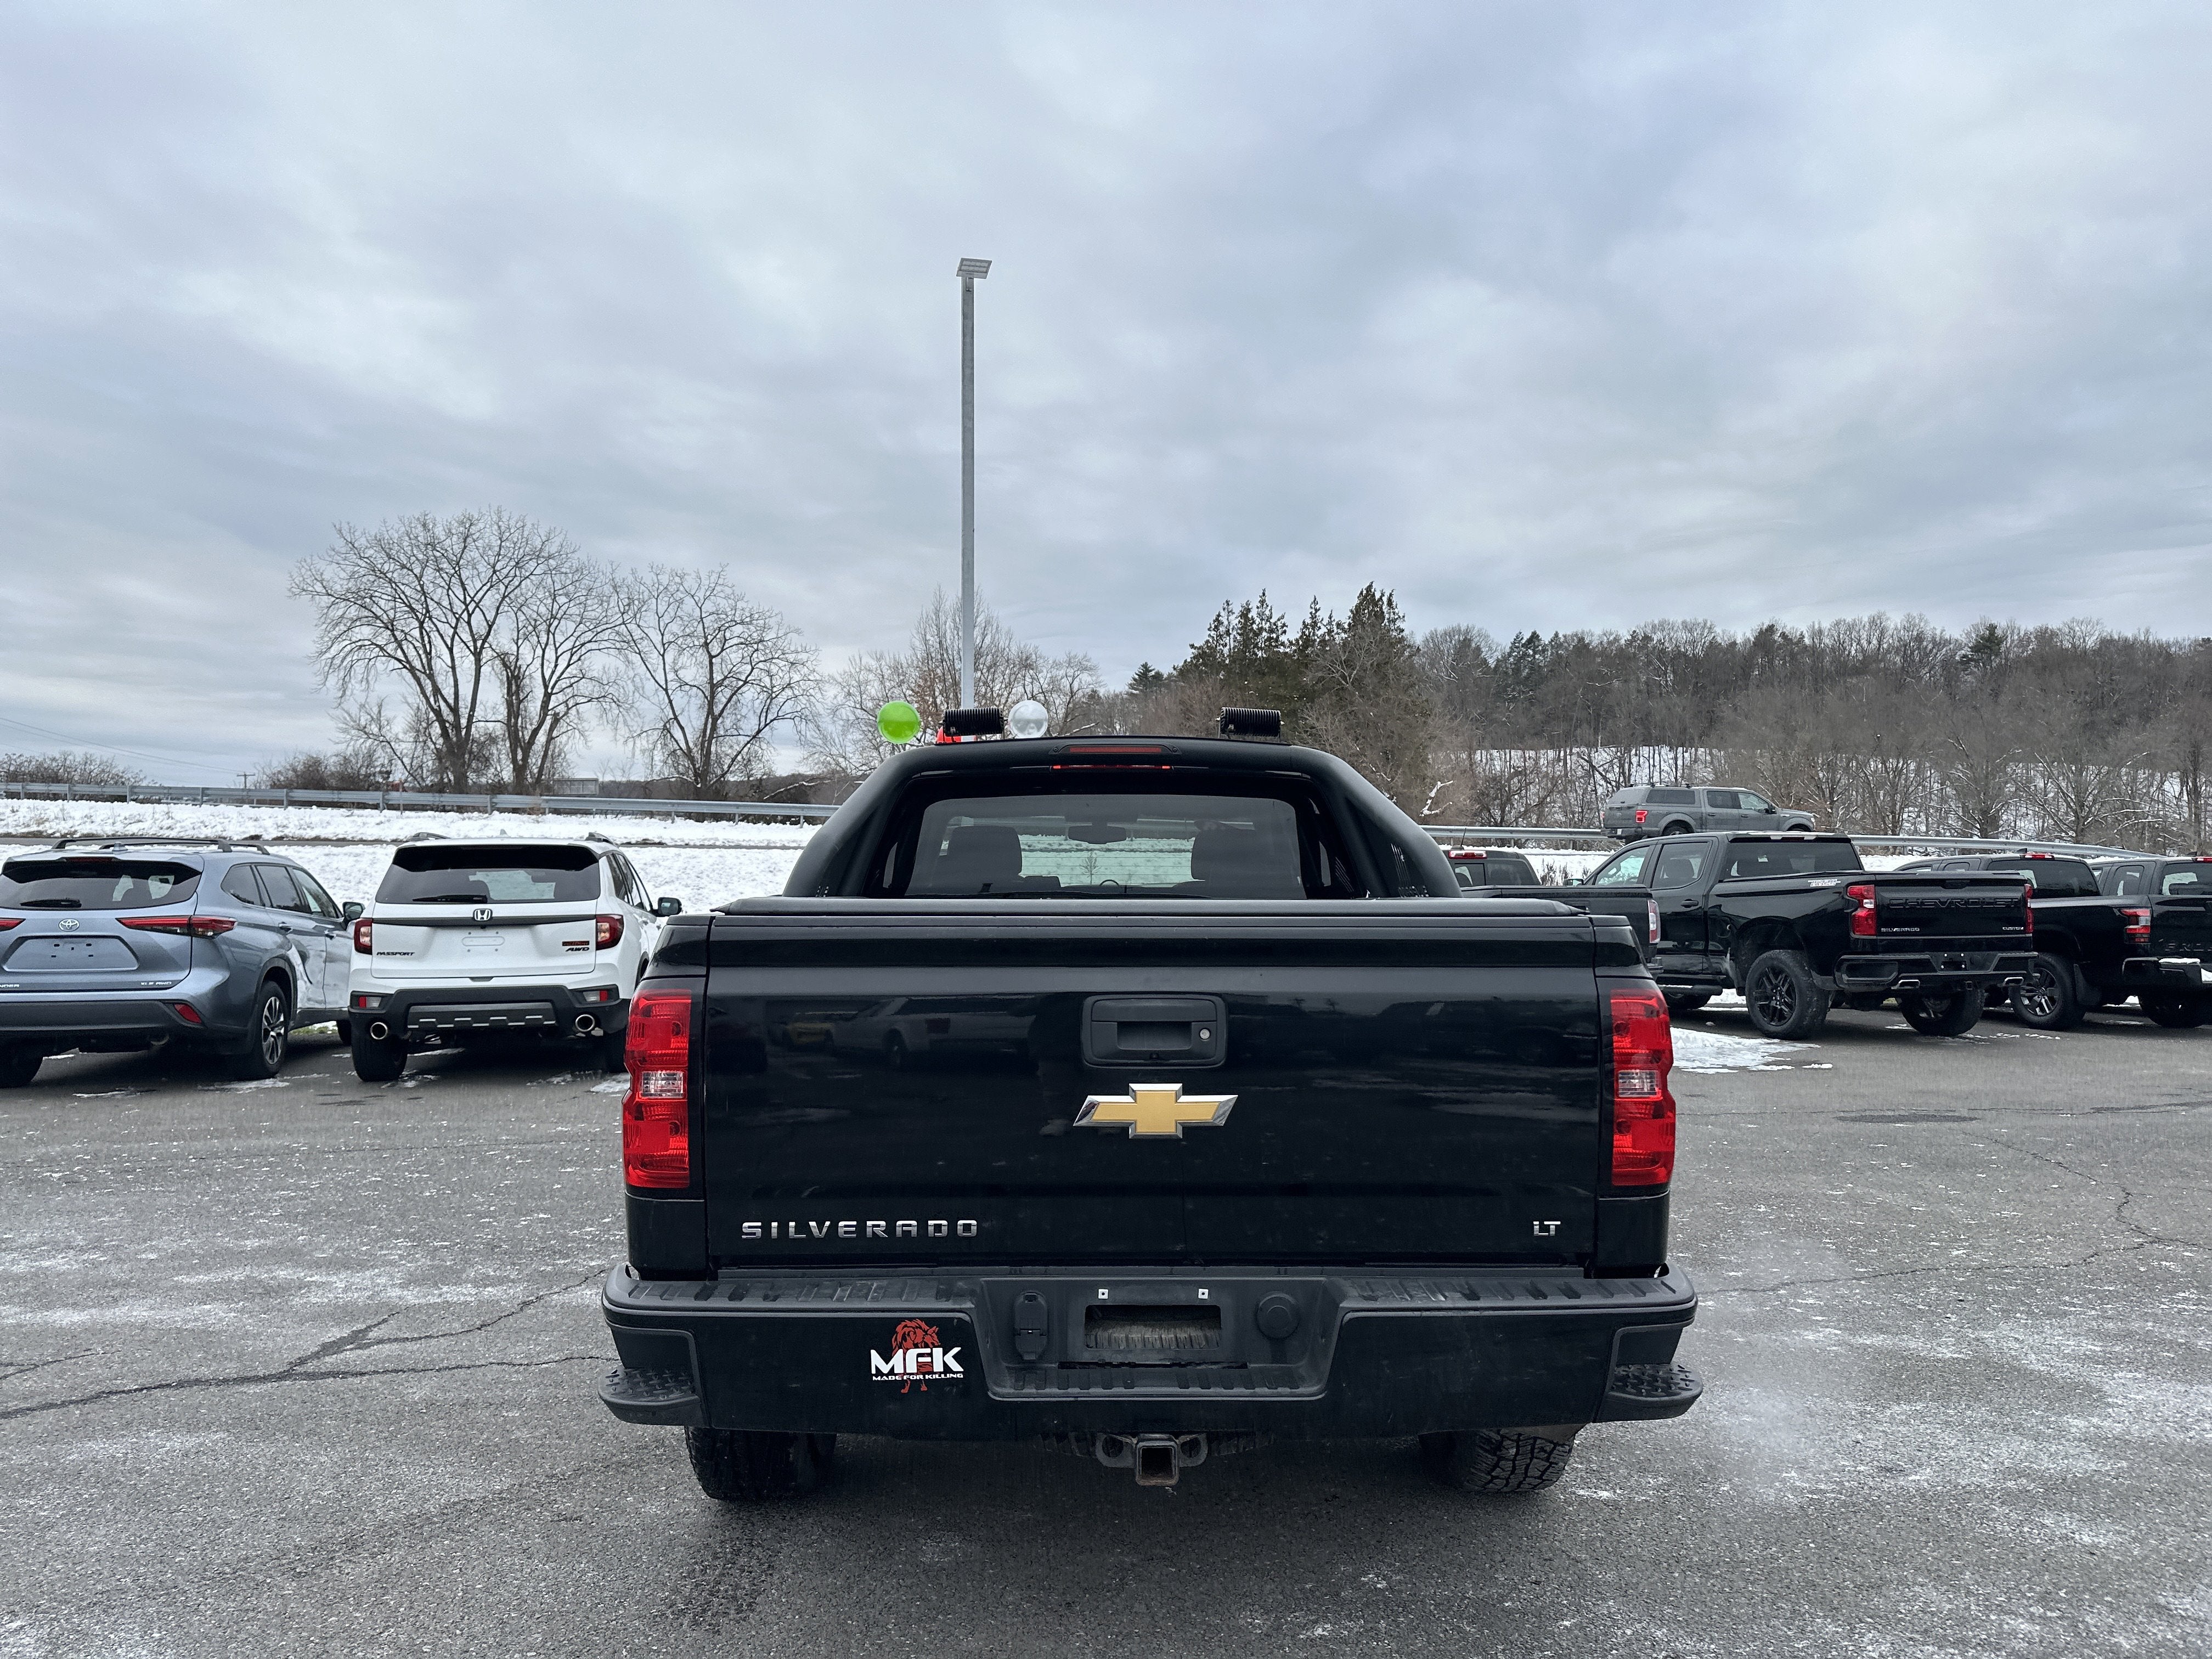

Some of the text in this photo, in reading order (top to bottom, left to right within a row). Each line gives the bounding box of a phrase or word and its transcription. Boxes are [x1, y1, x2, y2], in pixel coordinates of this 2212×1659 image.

[1889, 898, 2019, 909] CHEVROLET
[741, 1220, 978, 1239] SILVERADO
[1533, 1221, 1561, 1236] LT
[870, 1347, 964, 1374] MFK
